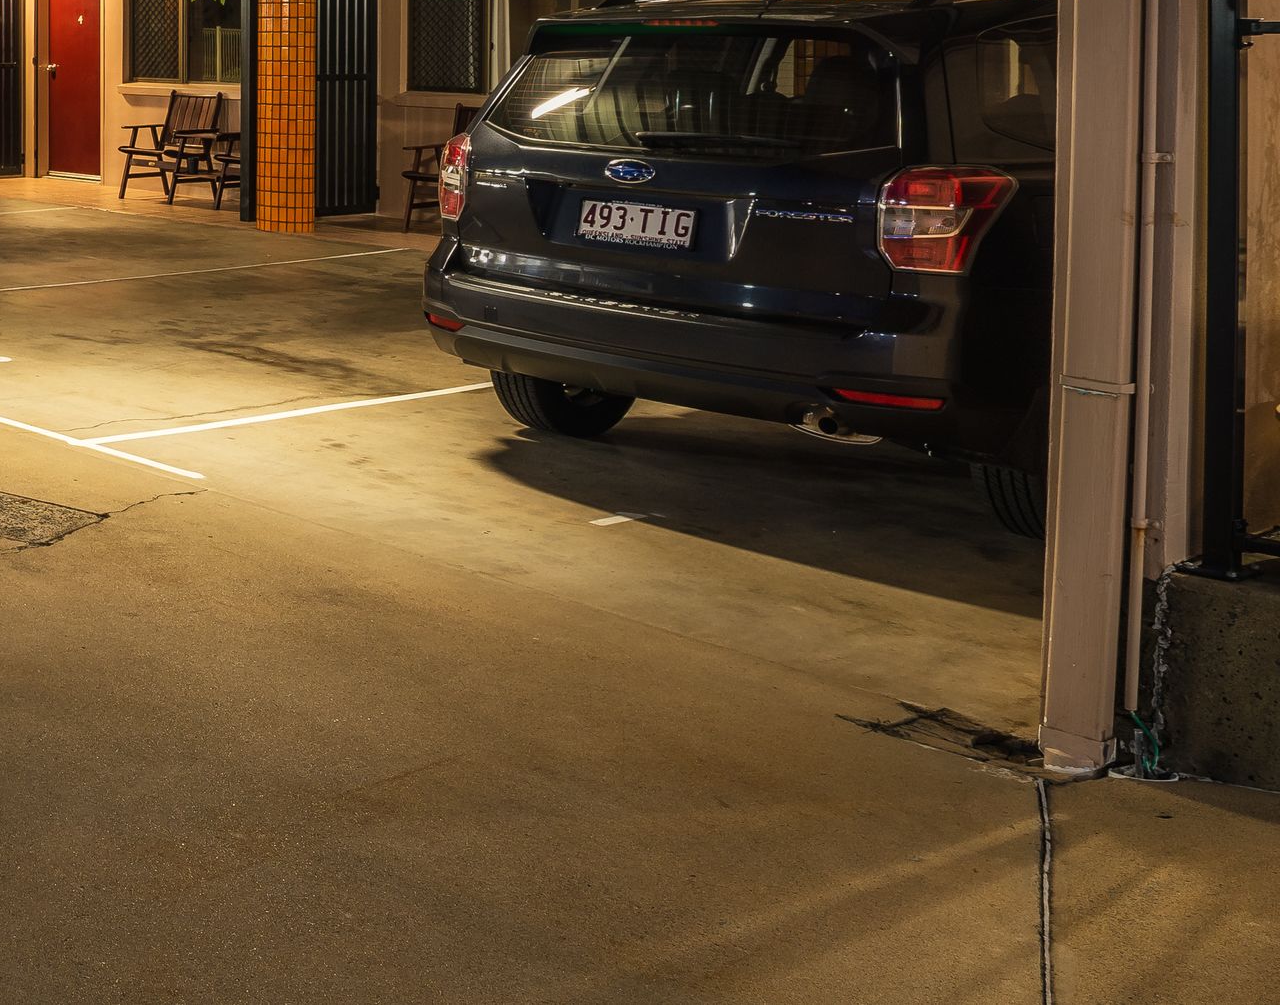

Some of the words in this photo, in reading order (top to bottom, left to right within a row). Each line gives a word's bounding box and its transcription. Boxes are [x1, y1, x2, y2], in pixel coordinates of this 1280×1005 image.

[77, 15, 83, 24] 4
[595, 235, 624, 244] MOTORS
[624, 239, 678, 250] ROCKHAMPTON
